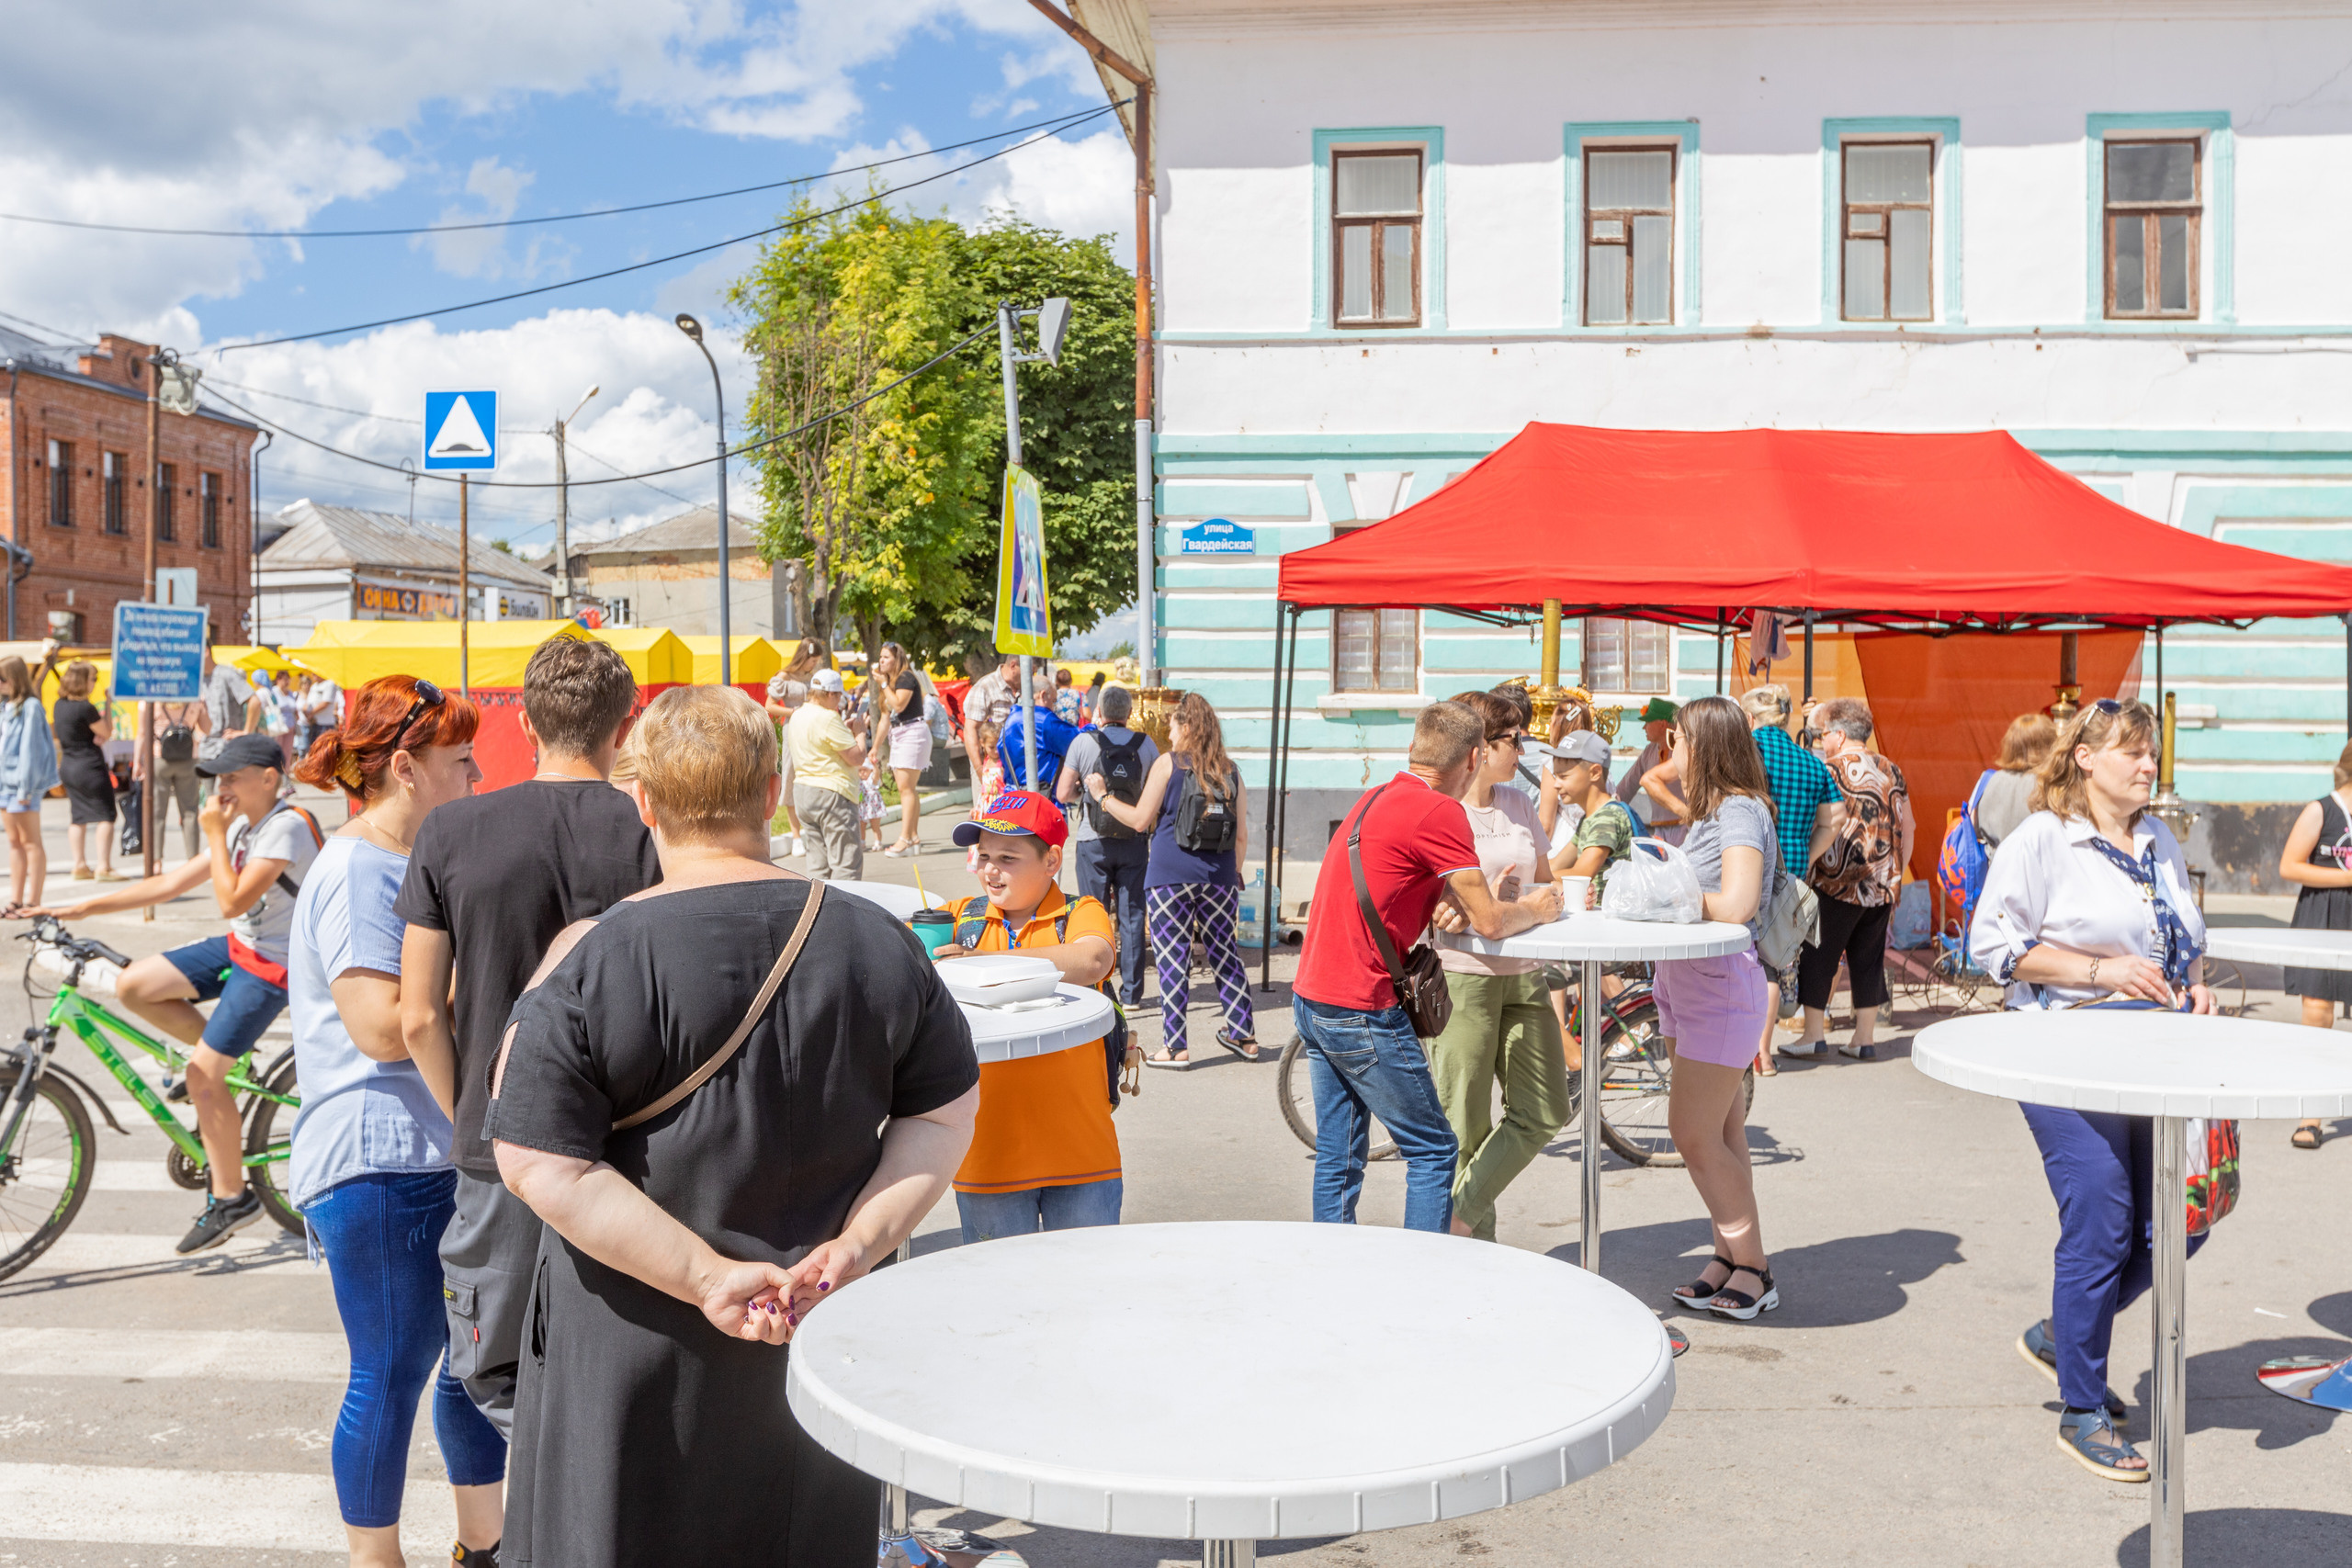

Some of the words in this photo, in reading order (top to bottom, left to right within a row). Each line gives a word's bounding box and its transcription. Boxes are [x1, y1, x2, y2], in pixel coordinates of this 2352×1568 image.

[1204, 525, 1234, 536] улица
[1182, 538, 1252, 553] Гвардейская
[85, 1031, 158, 1111] STELS
